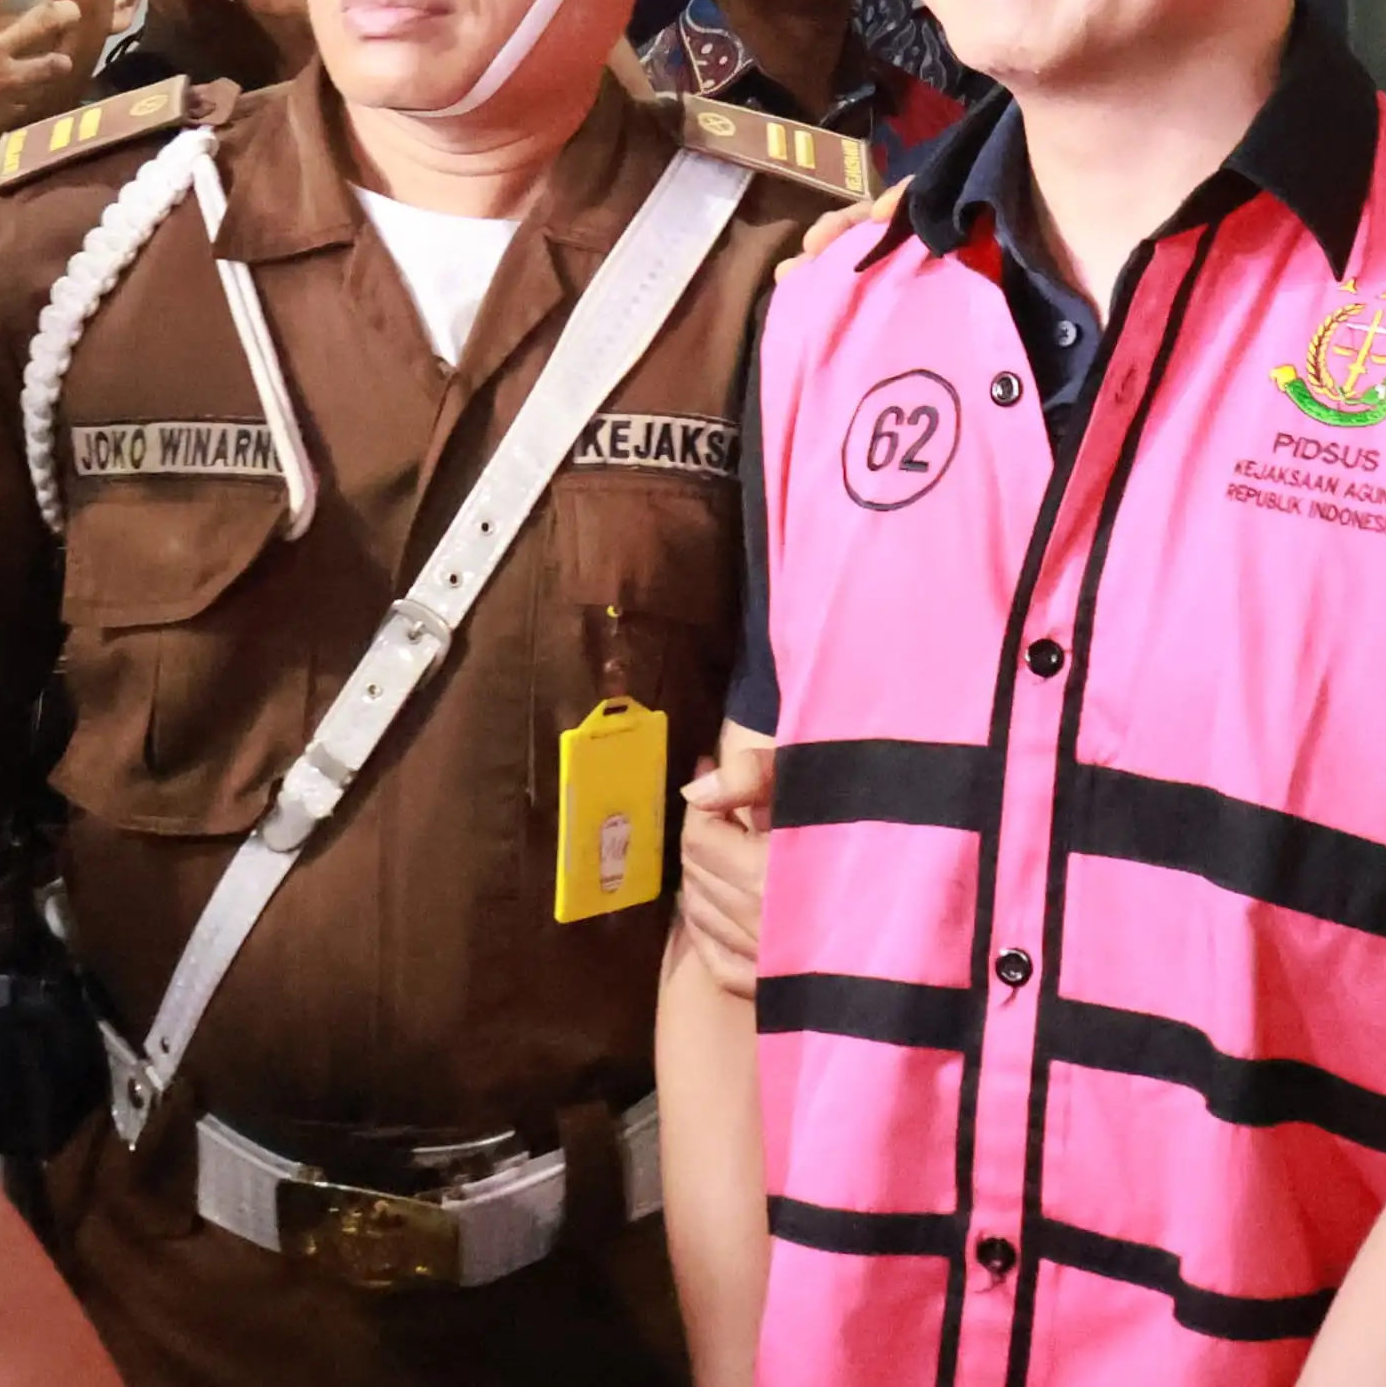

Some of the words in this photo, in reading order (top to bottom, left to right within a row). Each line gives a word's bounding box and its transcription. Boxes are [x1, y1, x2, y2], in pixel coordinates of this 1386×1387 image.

[82, 428, 148, 471] JOKO
[867, 405, 940, 473] 62
[1273, 431, 1381, 473] PIDSUS
[1225, 482, 1304, 516] REPUBLIK
[1233, 459, 1340, 497] KEJAKSAAN
